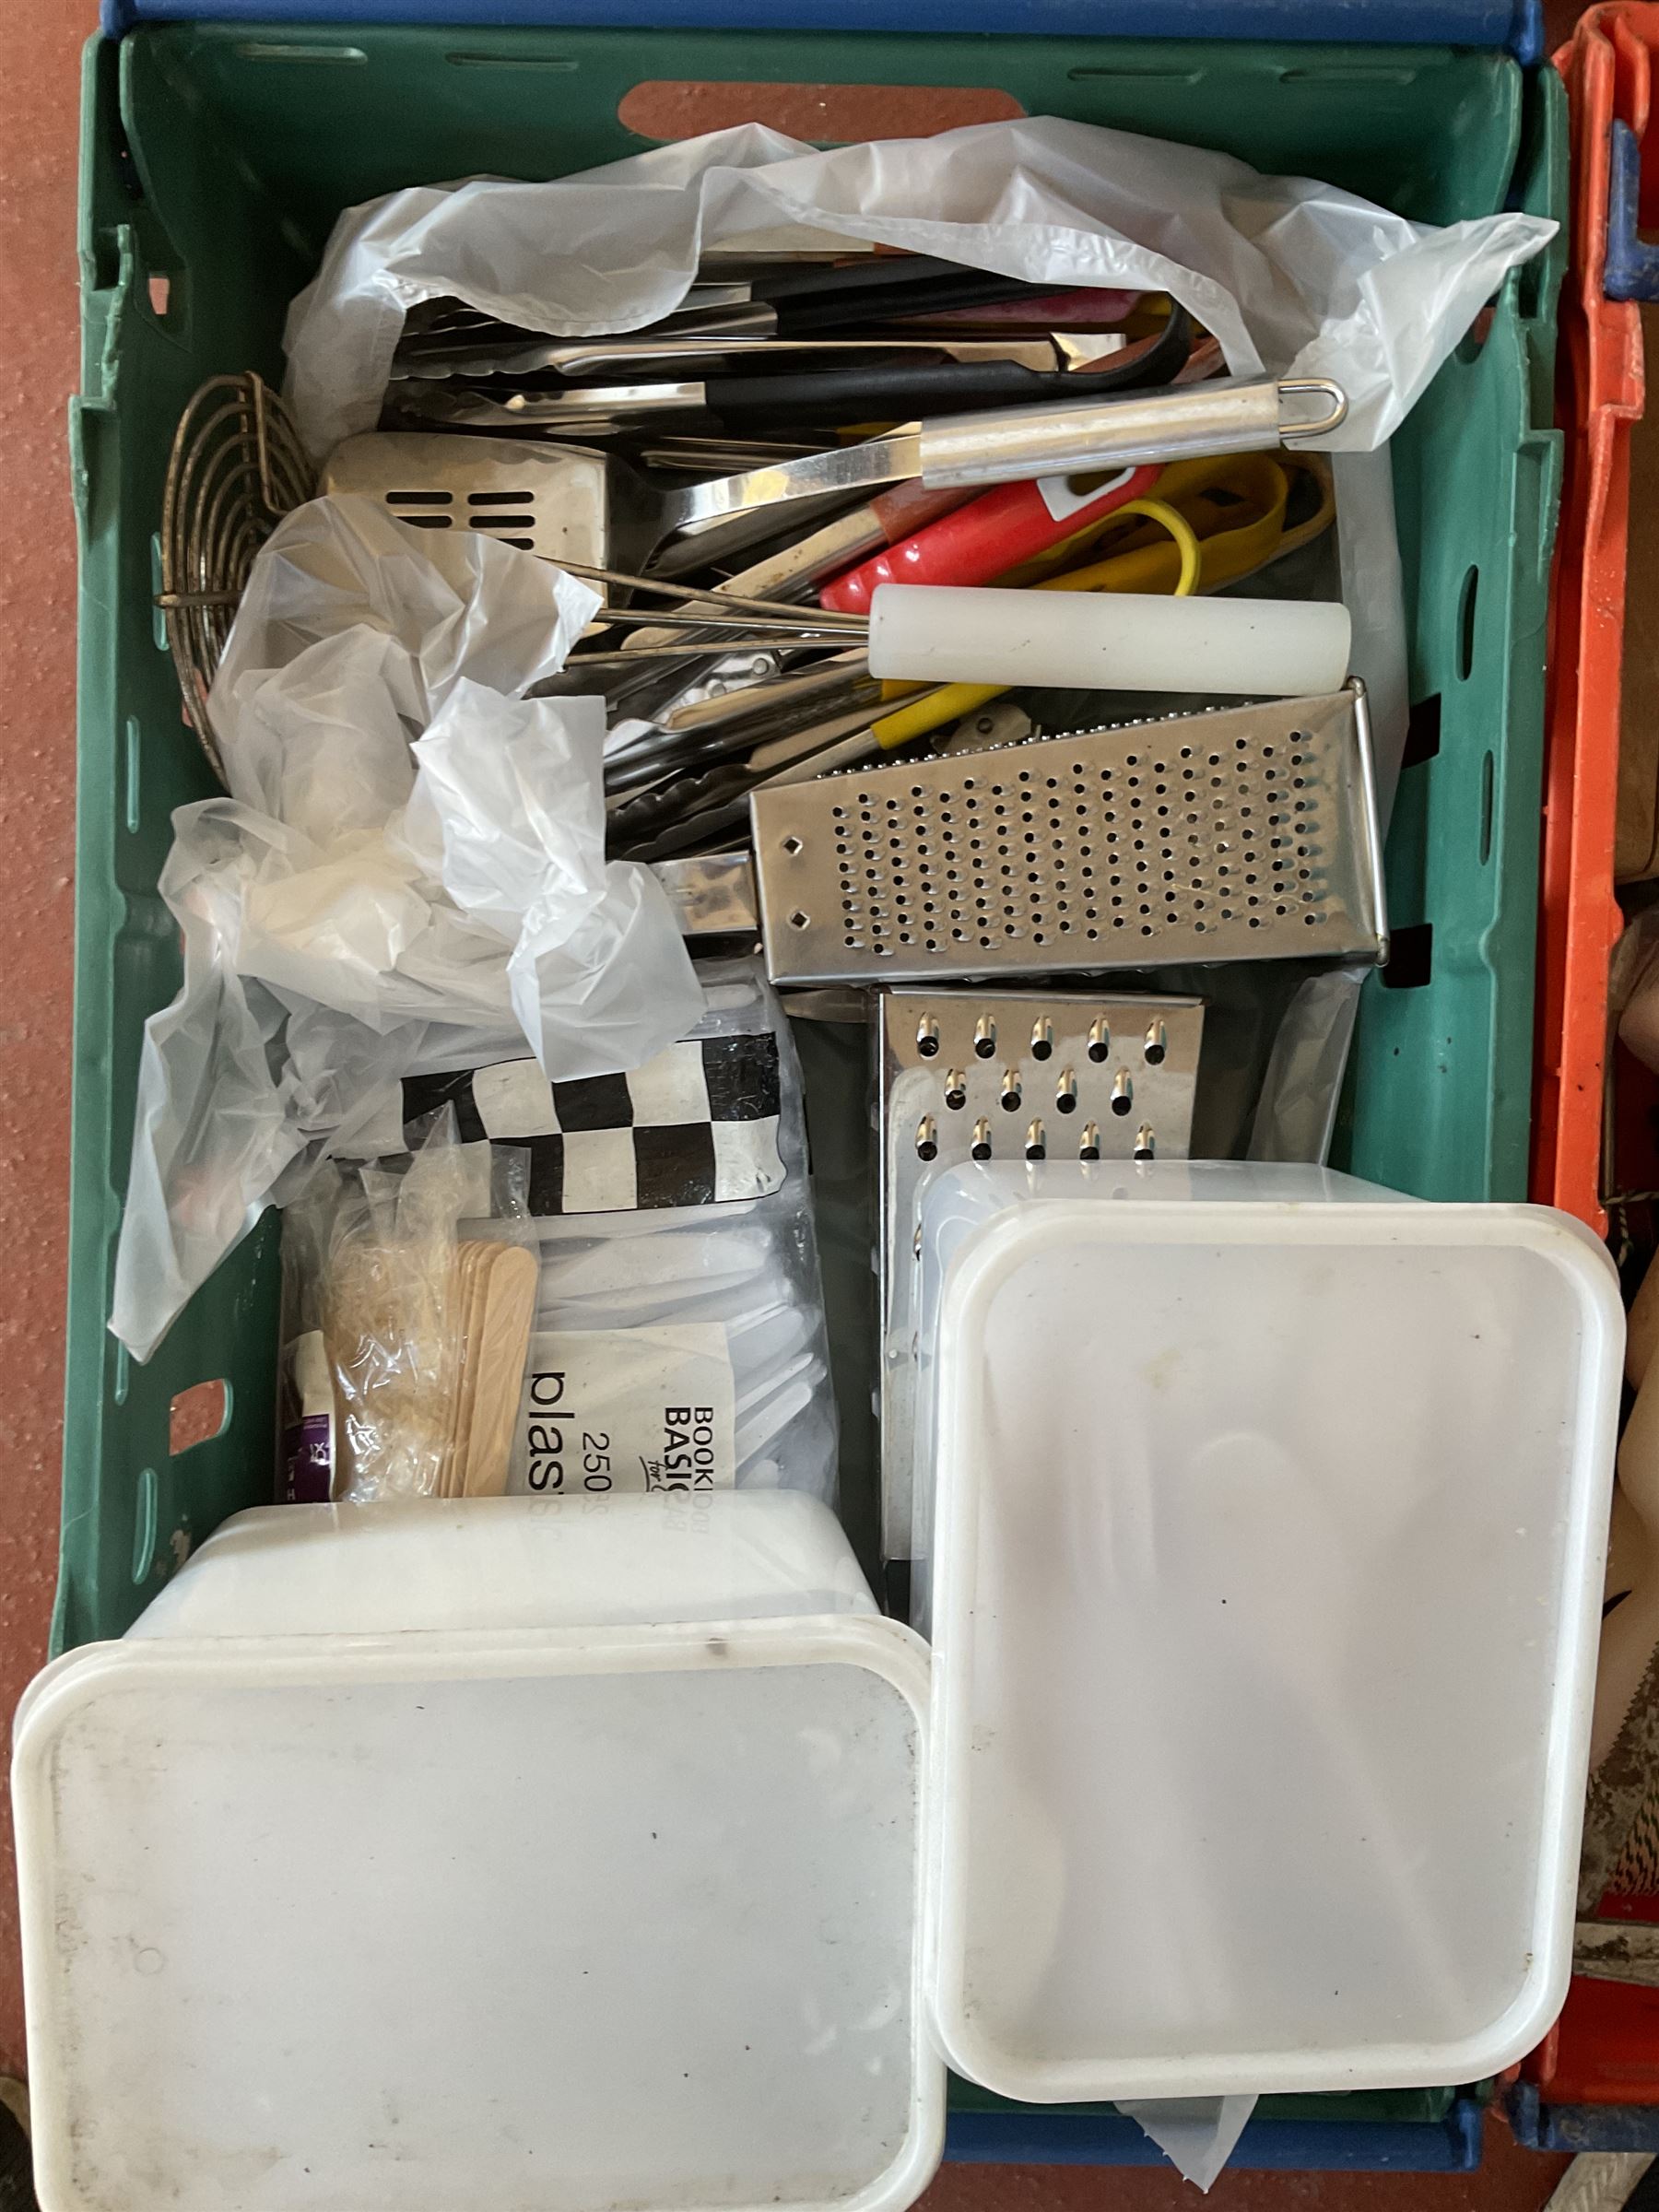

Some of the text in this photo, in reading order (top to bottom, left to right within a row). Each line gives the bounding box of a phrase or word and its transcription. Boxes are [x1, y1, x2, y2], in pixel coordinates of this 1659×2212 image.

[528, 1371, 575, 1495] plas
[582, 1432, 612, 1492] 250
[693, 1406, 714, 1491] BOOK
[647, 1460, 669, 1482] for
